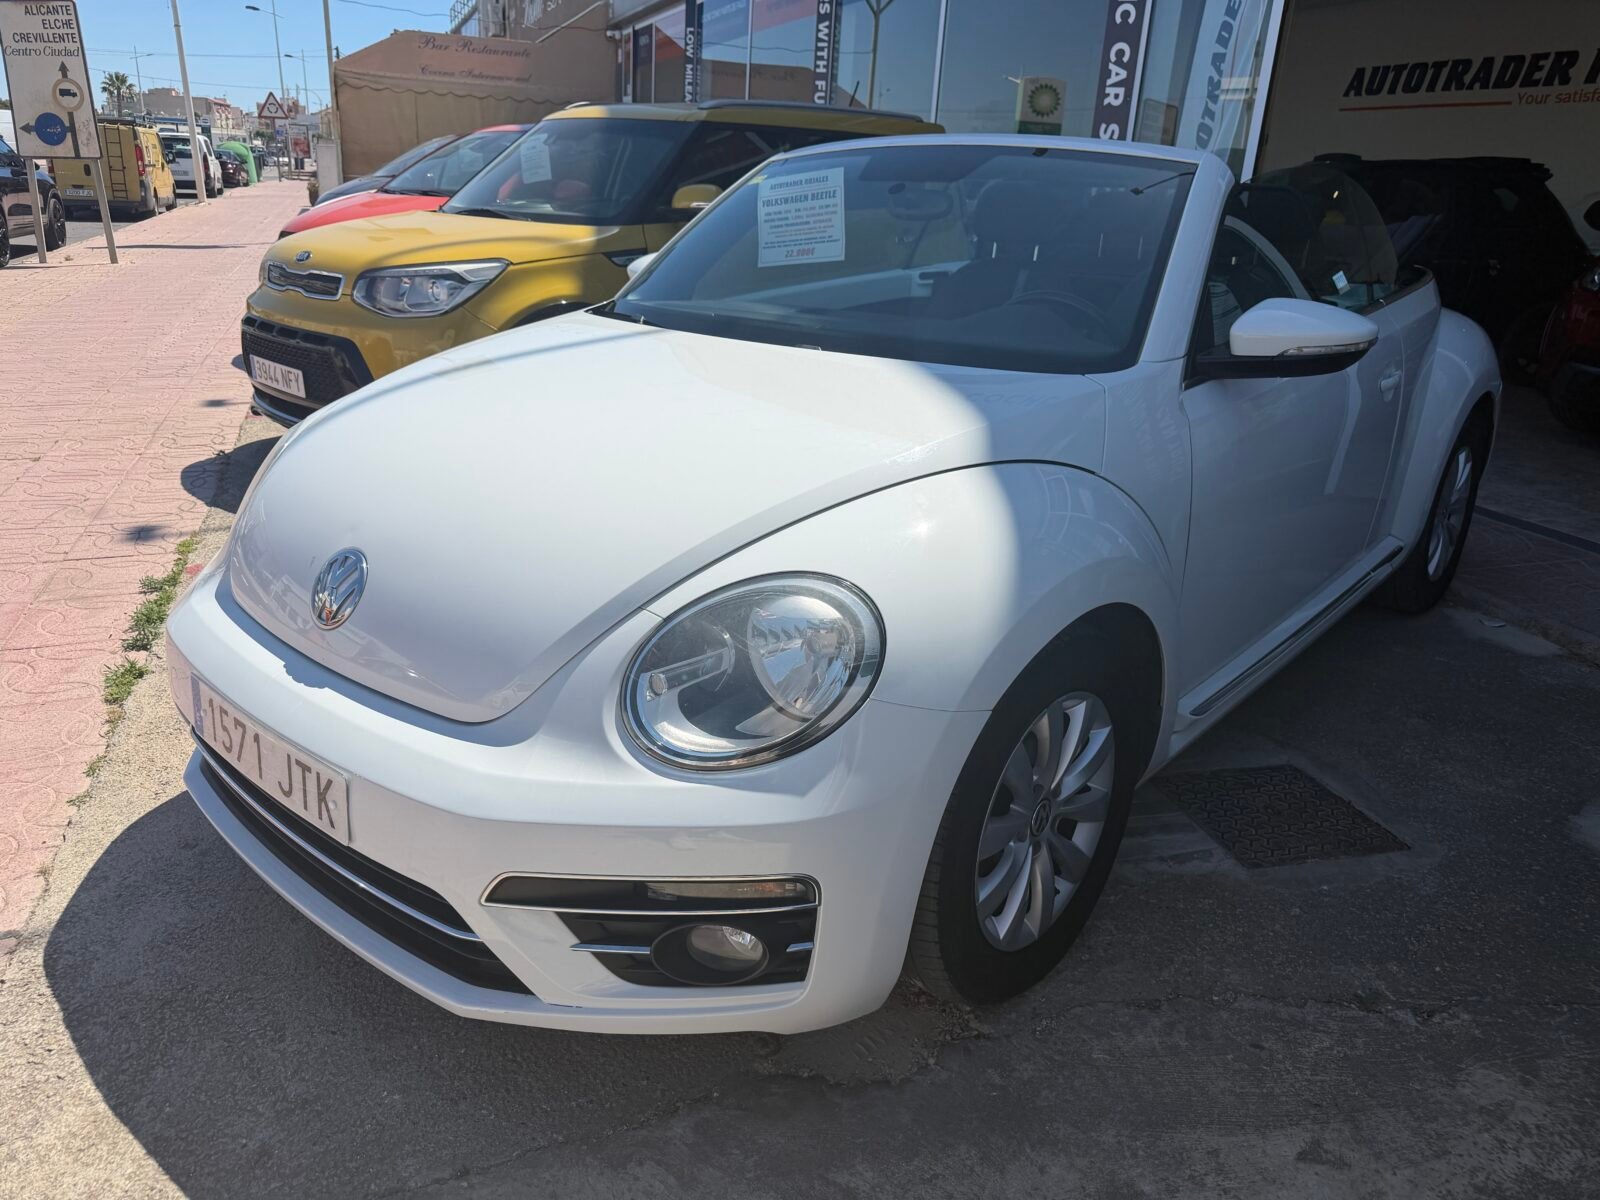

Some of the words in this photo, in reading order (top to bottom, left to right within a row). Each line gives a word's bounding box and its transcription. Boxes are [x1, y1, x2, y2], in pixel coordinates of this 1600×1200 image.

[24, 5, 72, 16] ALICANTE
[817, 0, 831, 14] S
[1114, 0, 1137, 25] C
[41, 19, 75, 30] ELCHE
[12, 32, 78, 44] CREVILLENTE
[418, 35, 450, 52] Bar
[455, 39, 532, 59] Restaurante
[684, 27, 695, 58] LOW
[815, 21, 830, 73] WITH
[4, 45, 42, 57] Centro
[43, 46, 80, 57] Ciudad
[684, 64, 694, 103] MILEA
[1103, 42, 1131, 107] CAR
[1195, 0, 1242, 151] OTRADE
[1342, 50, 1580, 98] AUTOTRADER
[813, 80, 827, 104] FU
[1517, 91, 1552, 106] Your
[761, 193, 810, 208] VOLKSWAGEN
[810, 189, 838, 202] BEETLE
[255, 359, 280, 386] 3944
[280, 368, 301, 393] NFY
[208, 697, 263, 780] 1571
[277, 752, 336, 830] JTK
